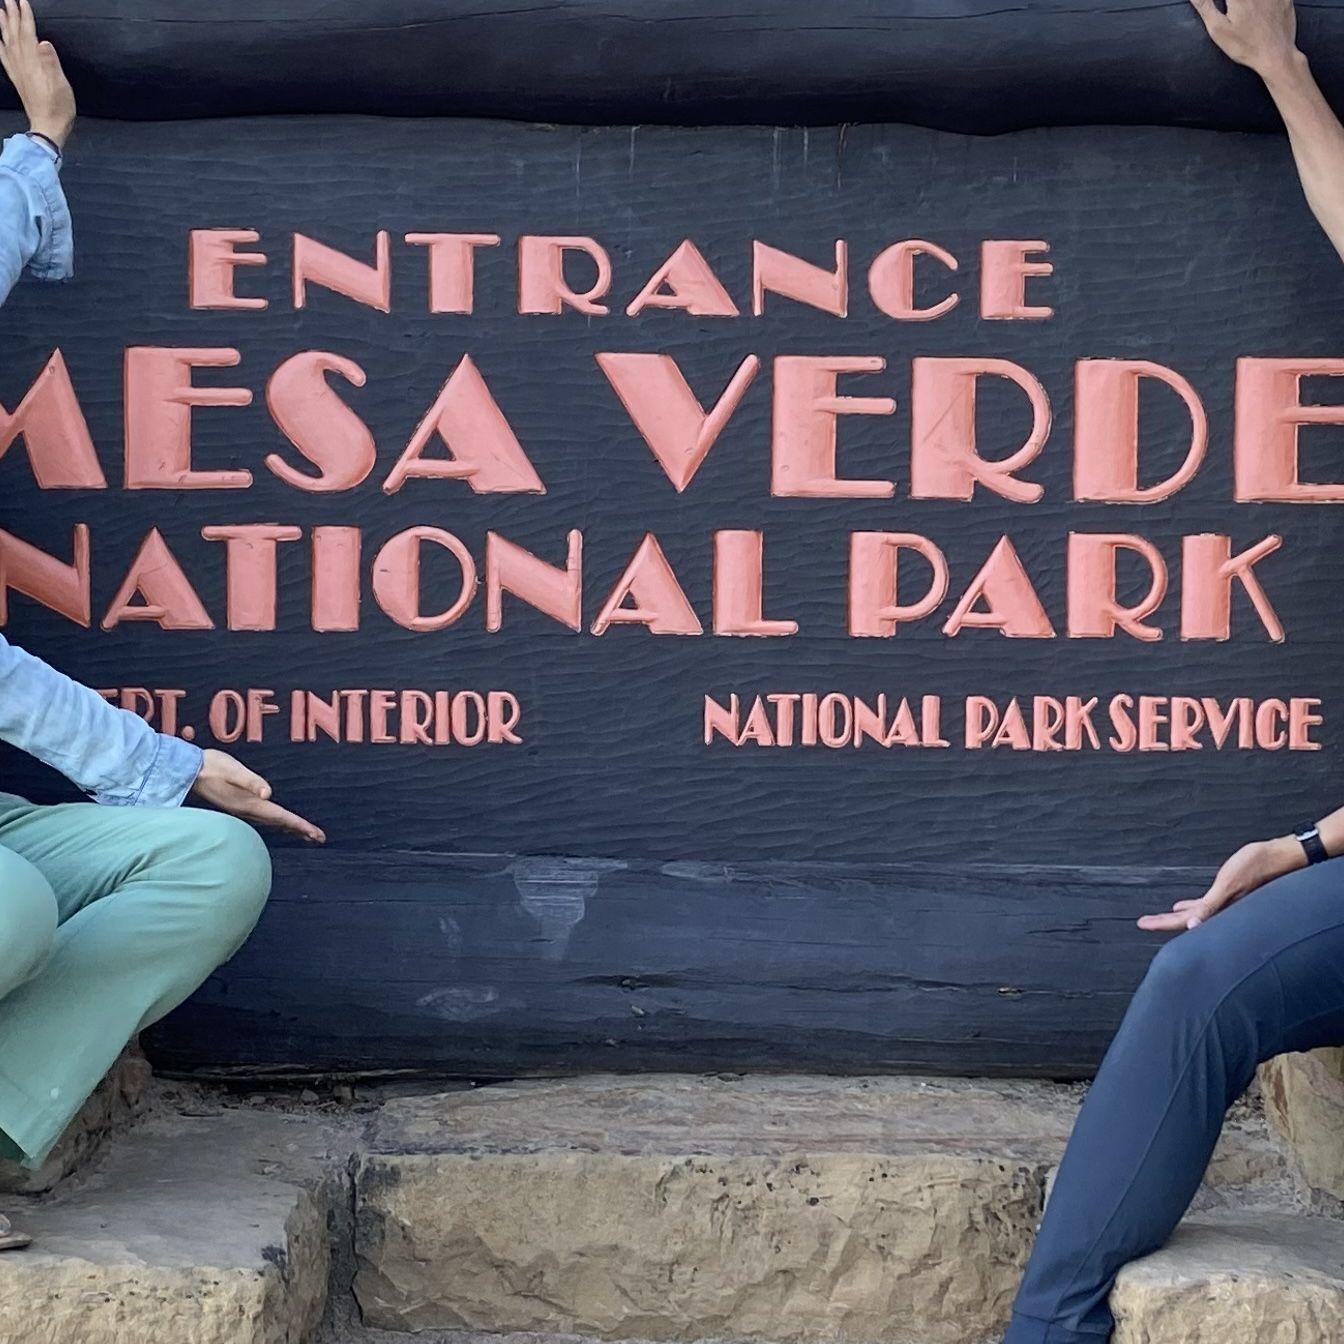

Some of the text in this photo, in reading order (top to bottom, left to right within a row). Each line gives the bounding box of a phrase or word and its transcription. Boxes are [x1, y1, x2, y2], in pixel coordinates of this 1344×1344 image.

[188, 228, 1054, 321] ENTRANCE
[847, 530, 1285, 643] PARK
[96, 686, 523, 747] PT. OF INTERIOR
[703, 692, 1324, 752] NATIONAL PARK SERVICE
